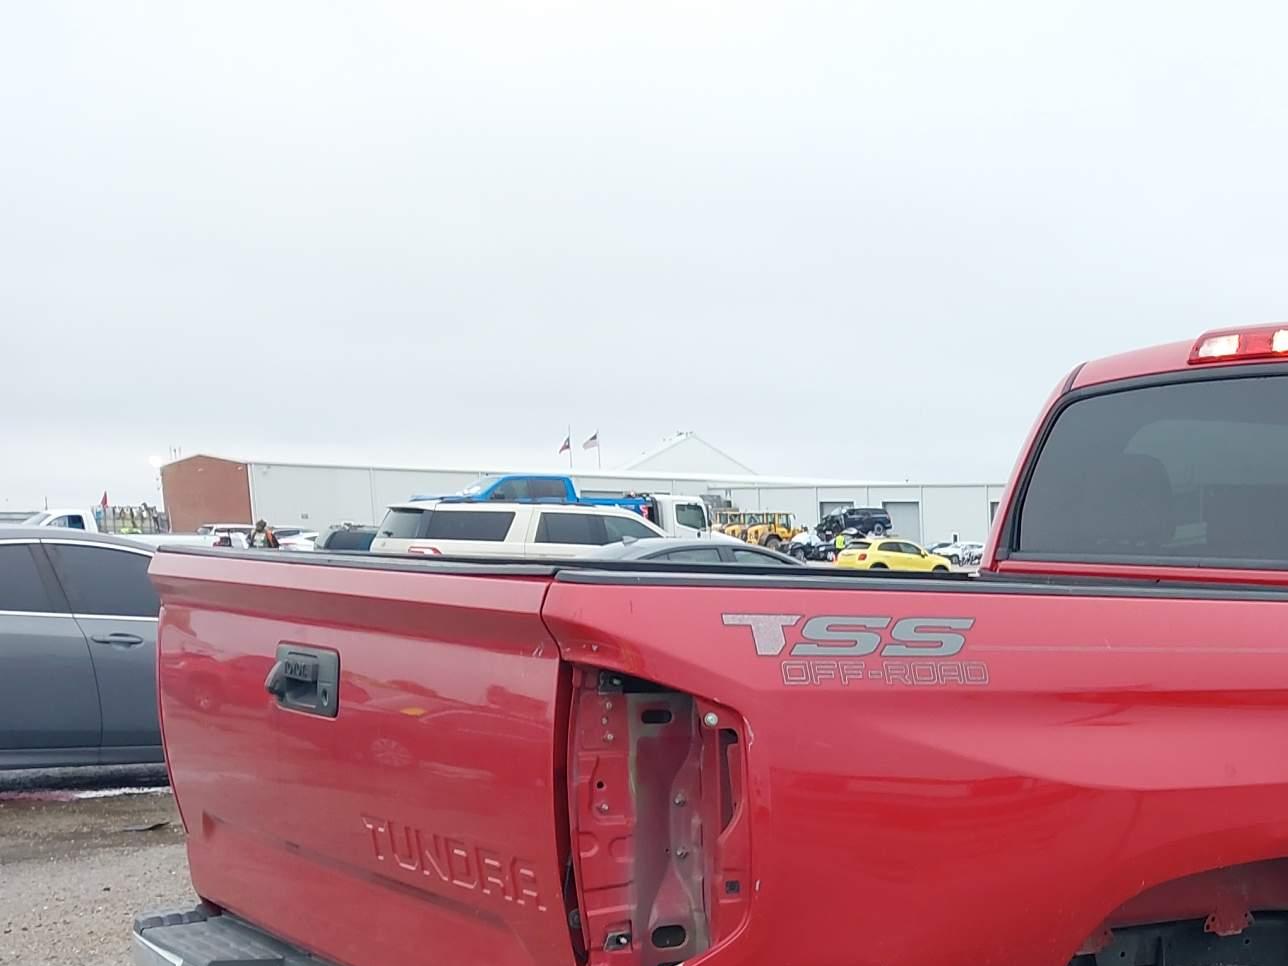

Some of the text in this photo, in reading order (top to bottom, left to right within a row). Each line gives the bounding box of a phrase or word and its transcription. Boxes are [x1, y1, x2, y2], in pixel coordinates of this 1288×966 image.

[721, 613, 976, 656] TSS
[781, 660, 990, 686] OFF-ROAD
[361, 813, 547, 912] TUNDRA
